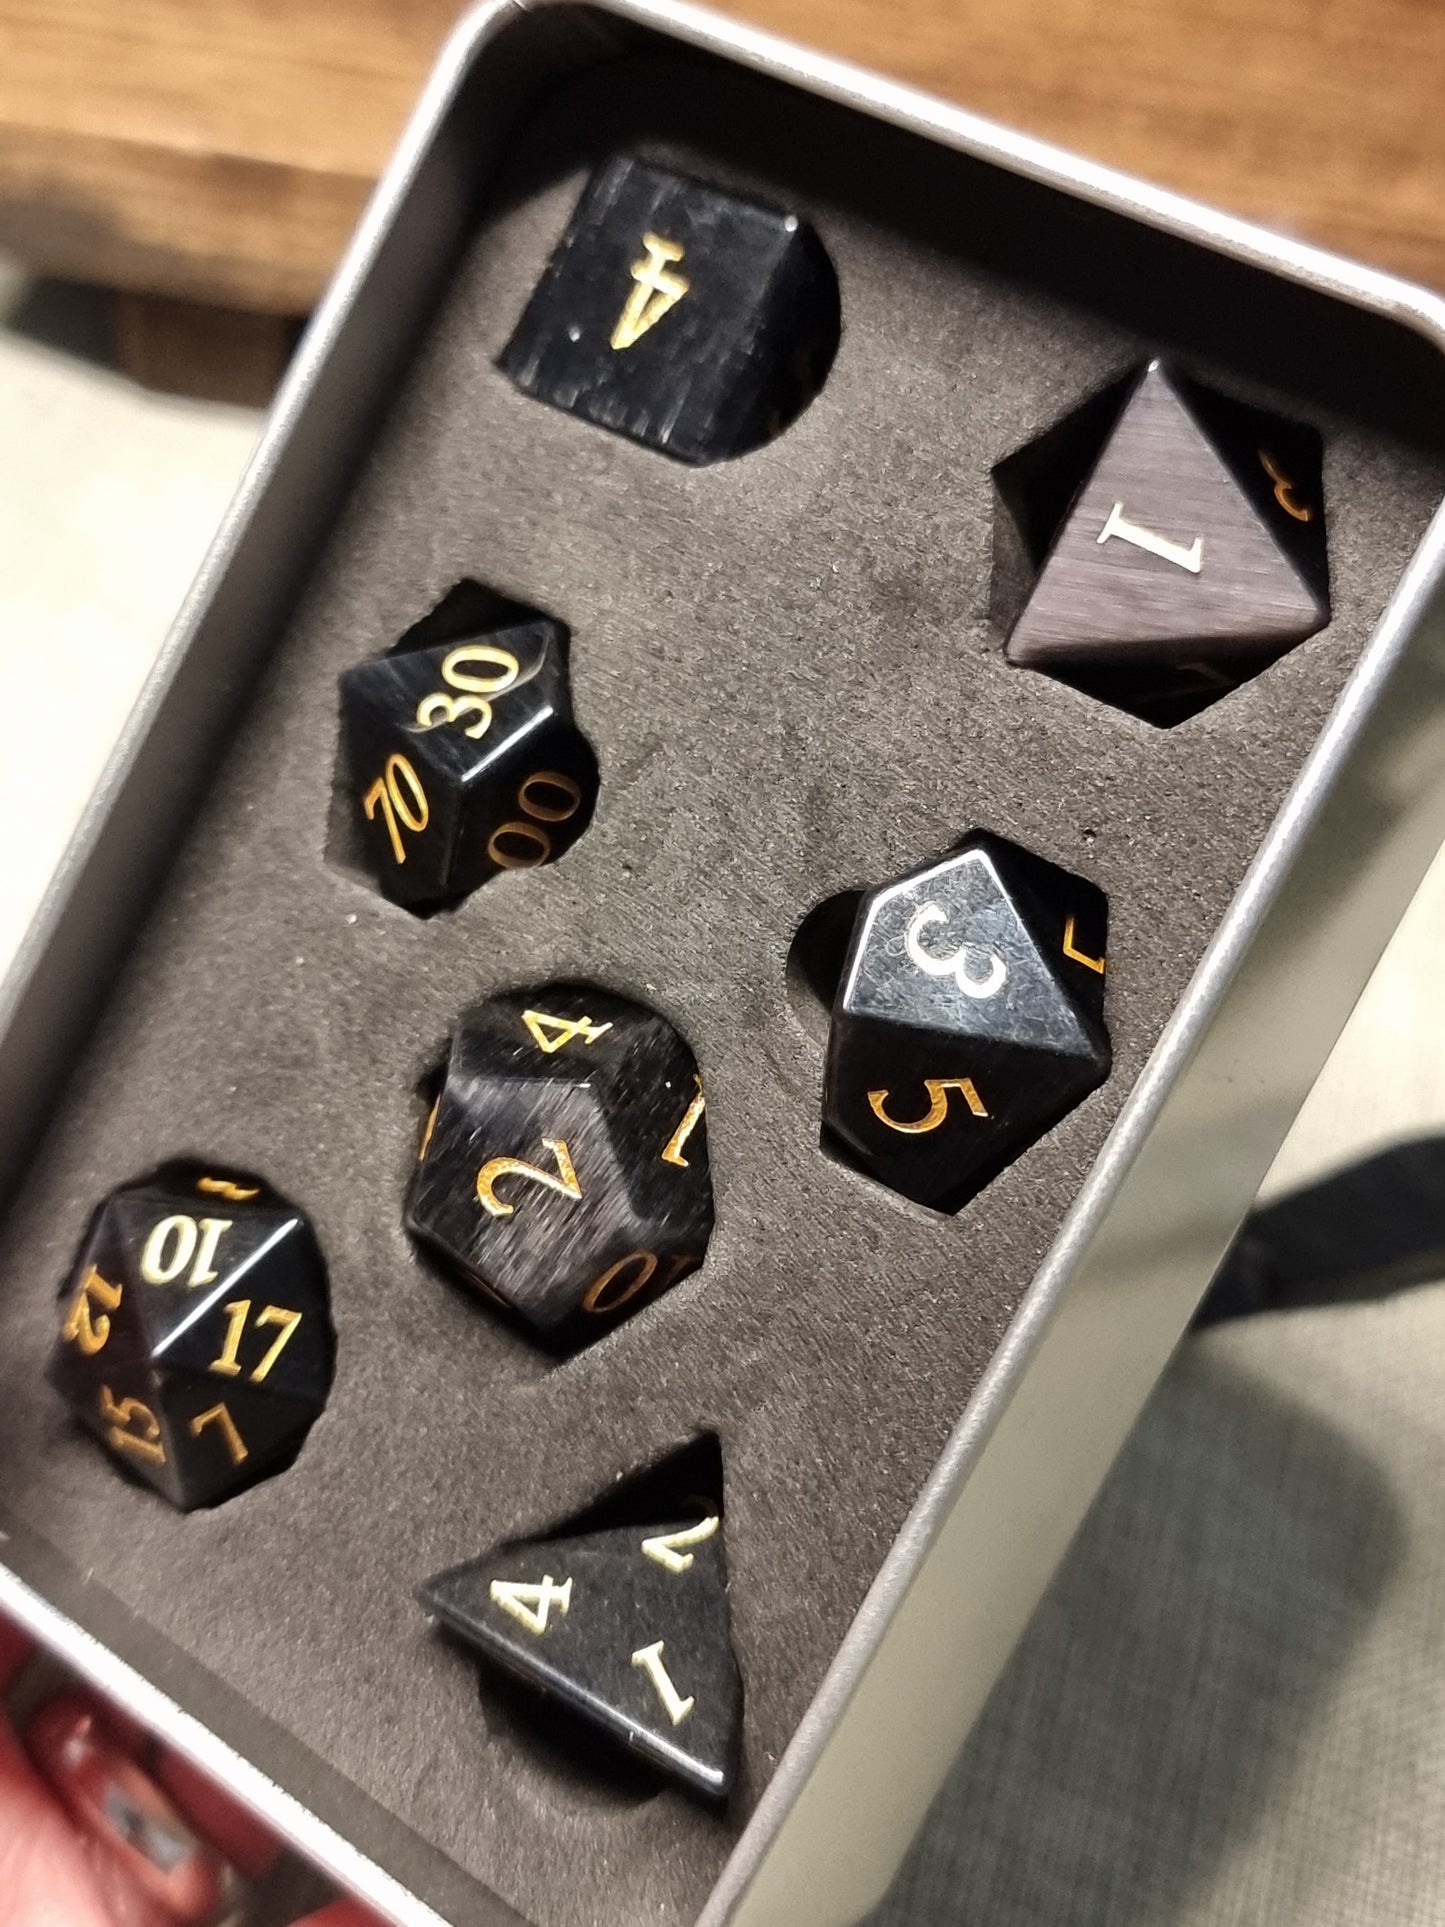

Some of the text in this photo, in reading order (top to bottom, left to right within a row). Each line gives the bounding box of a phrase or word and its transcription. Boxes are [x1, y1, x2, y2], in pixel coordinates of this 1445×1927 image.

[610, 231, 689, 350] 4
[1096, 502, 1204, 574] 1
[417, 645, 519, 739] 30
[364, 754, 429, 864] 70
[488, 771, 581, 870] 00
[907, 901, 1007, 999] 3
[521, 1010, 613, 1053] 4
[867, 1078, 988, 1133] 5
[476, 1137, 582, 1217] 2
[140, 1215, 233, 1288] 10
[61, 1263, 122, 1355] 12
[209, 1299, 302, 1384] 17
[100, 1384, 166, 1466] 15
[190, 1402, 248, 1464] 7
[490, 1574, 573, 1636] 4
[631, 1640, 694, 1725] 1
